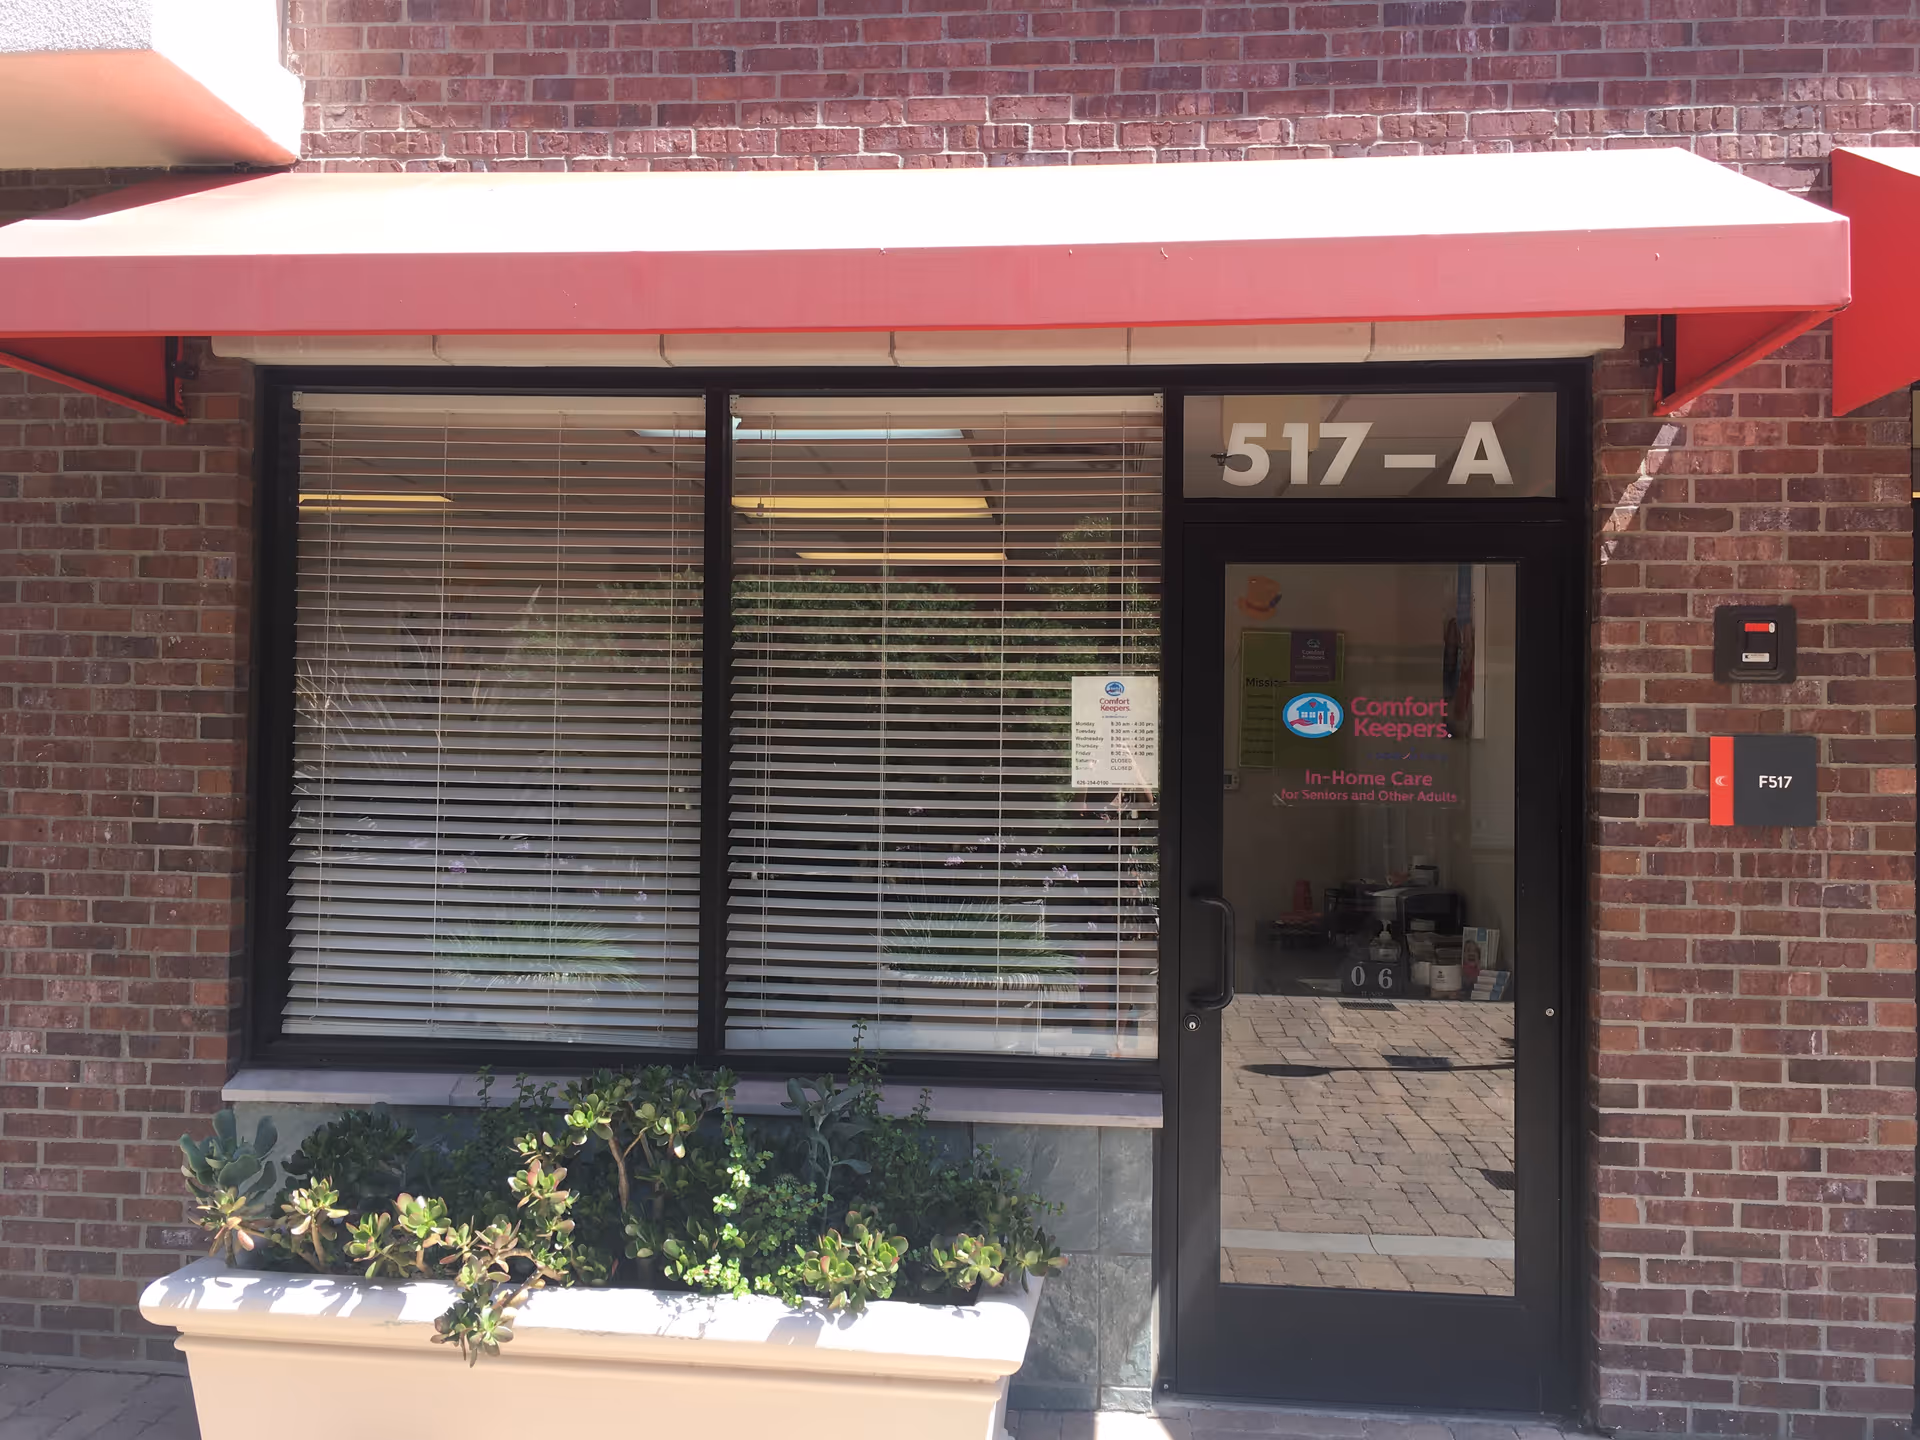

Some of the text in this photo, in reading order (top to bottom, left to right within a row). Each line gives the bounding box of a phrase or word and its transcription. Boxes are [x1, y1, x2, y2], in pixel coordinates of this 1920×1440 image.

[1099, 697, 1130, 705] Comfort
[1350, 696, 1449, 718] Comfort
[1305, 769, 1433, 787] In-Home Care
[1758, 775, 1793, 789] F517
[1281, 788, 1459, 803] for Seniors and Other Adults
